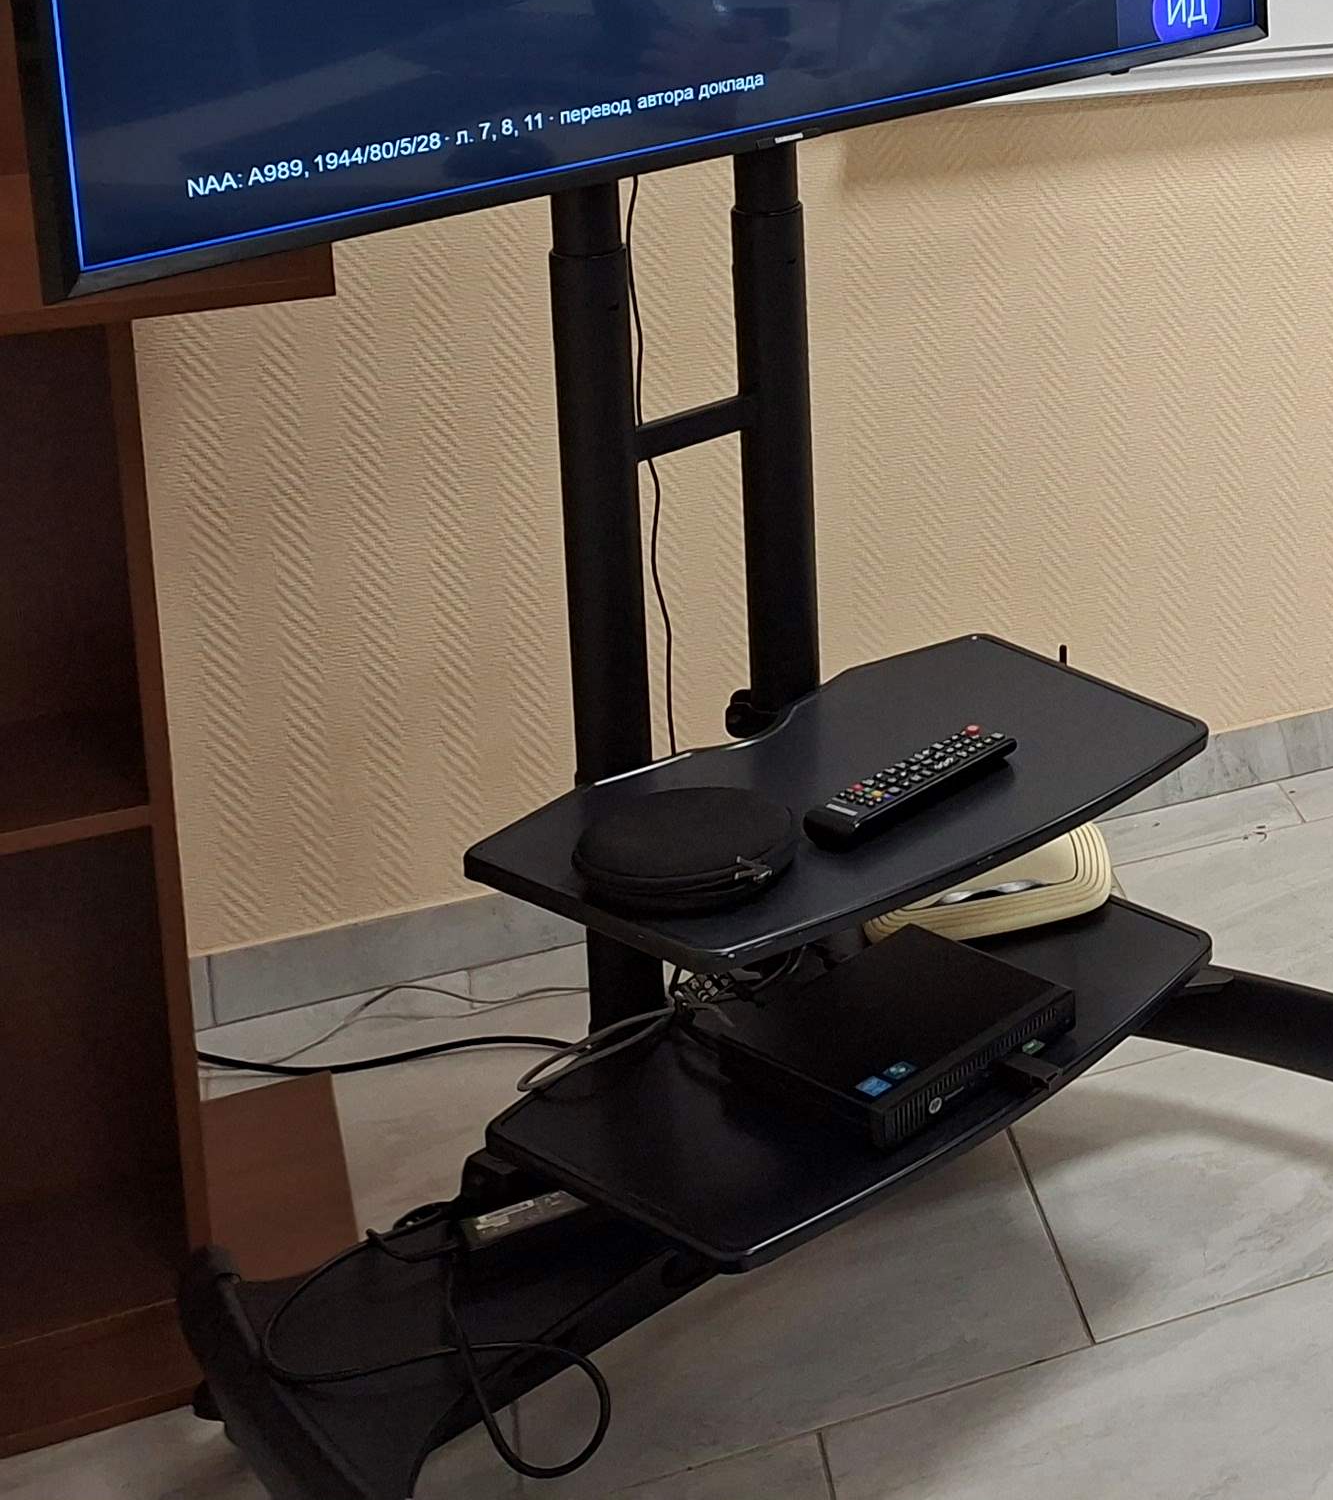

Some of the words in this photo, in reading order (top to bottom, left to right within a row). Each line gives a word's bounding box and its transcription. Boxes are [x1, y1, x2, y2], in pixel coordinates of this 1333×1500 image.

[187, 171, 244, 198] NAA:
[248, 158, 310, 186] A989,
[313, 131, 442, 173] 1944/80/5/28
[455, 129, 475, 146] л.
[478, 121, 498, 142] 7,
[501, 118, 519, 138] 8,
[523, 112, 544, 132] 11
[559, 98, 633, 125] перевод
[637, 84, 695, 110] автора
[698, 71, 765, 101] доклада
